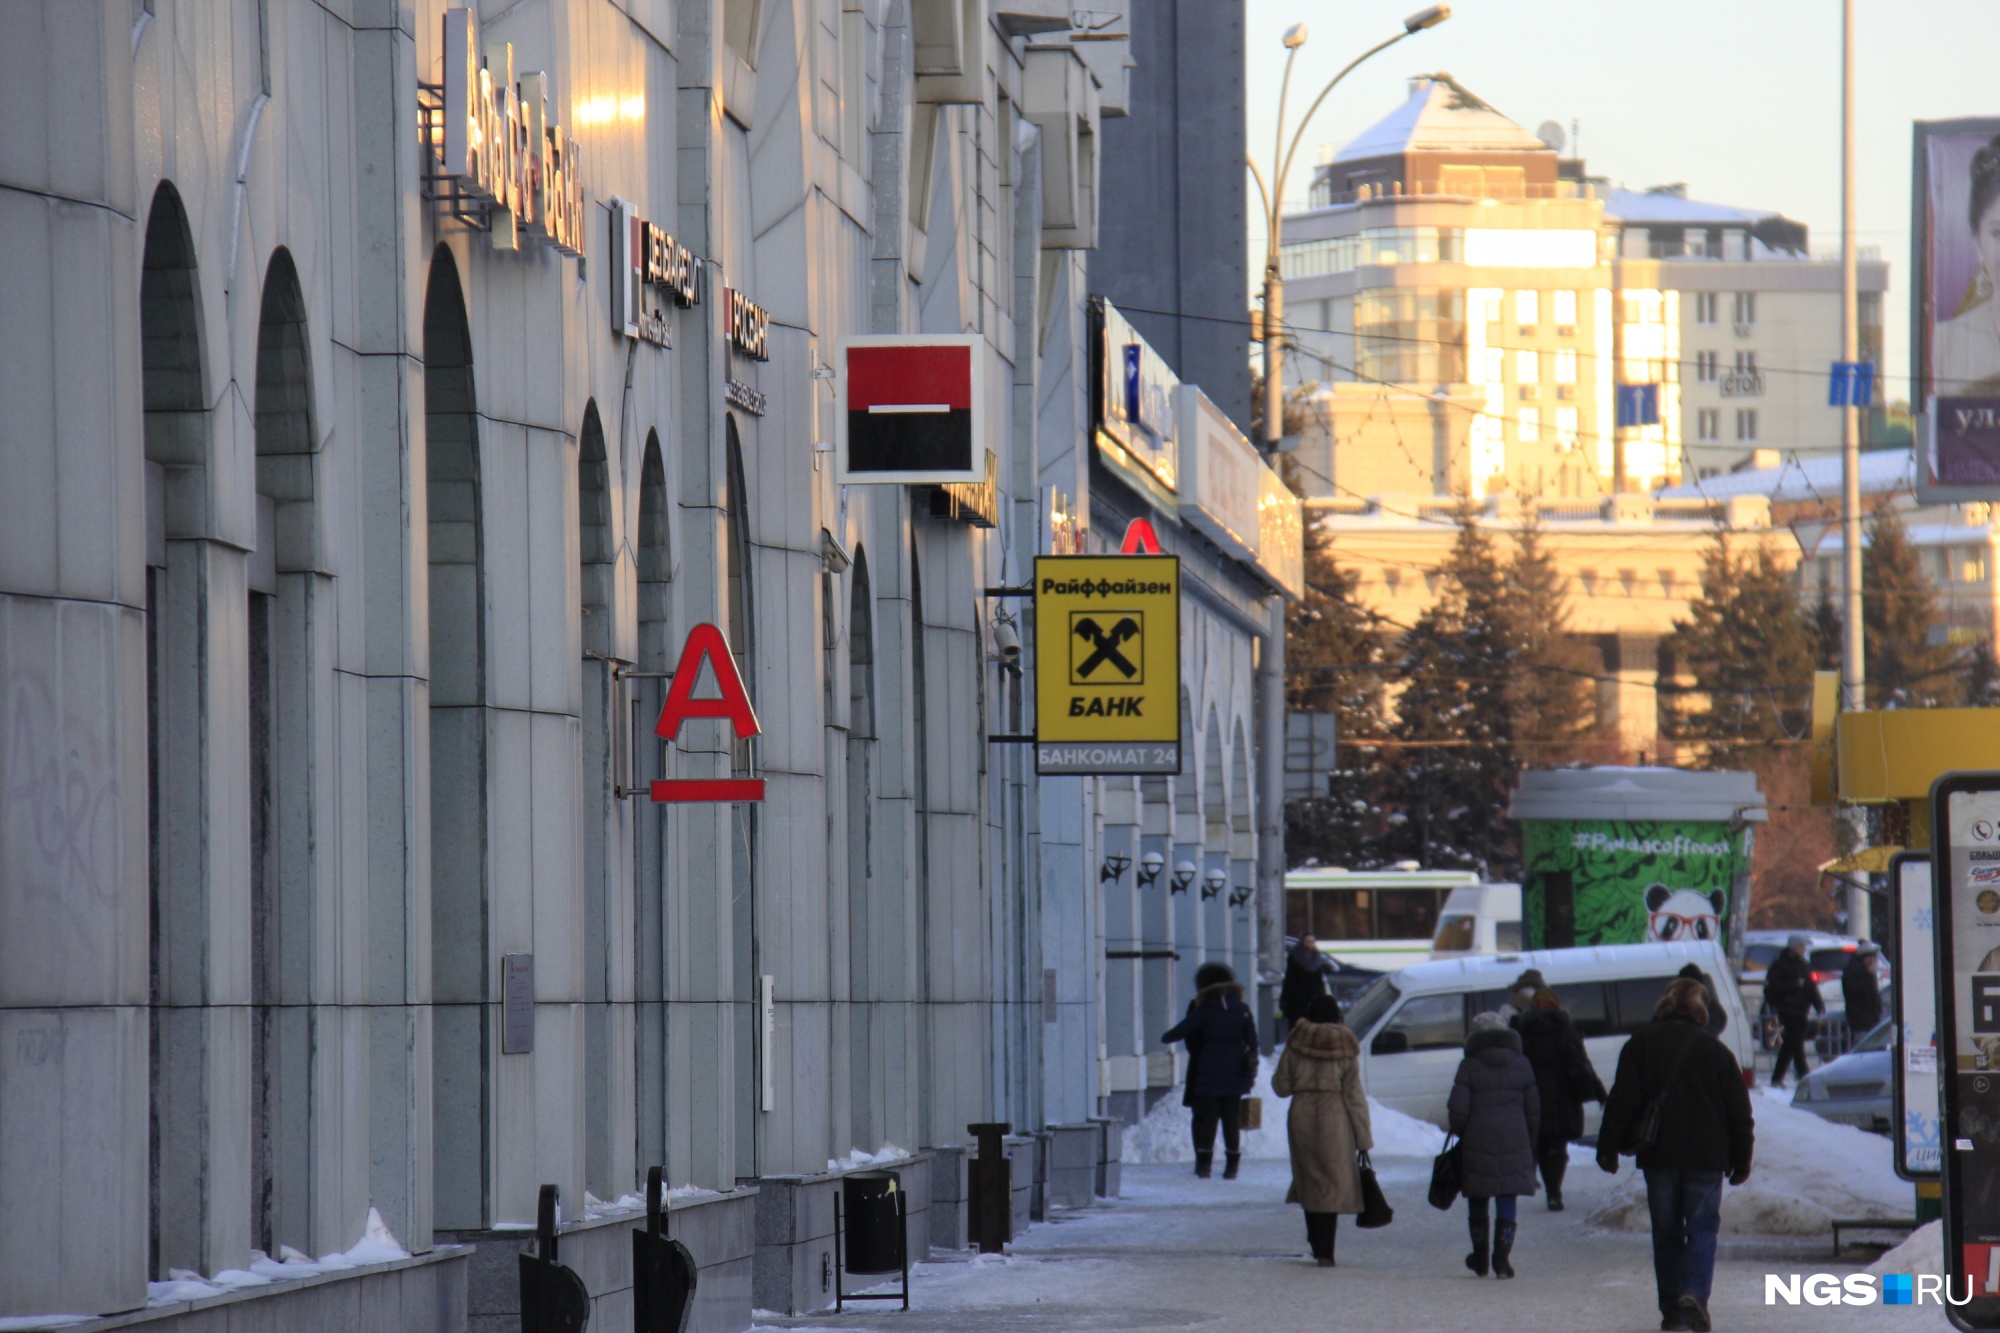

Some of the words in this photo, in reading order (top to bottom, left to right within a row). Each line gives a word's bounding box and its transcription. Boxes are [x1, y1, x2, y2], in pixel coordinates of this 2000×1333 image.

[1042, 578, 1171, 599] Райффайзен
[1068, 697, 1145, 717] БАНК
[1039, 748, 1147, 766] БАНКОМАТ
[1153, 748, 1177, 766] 24
